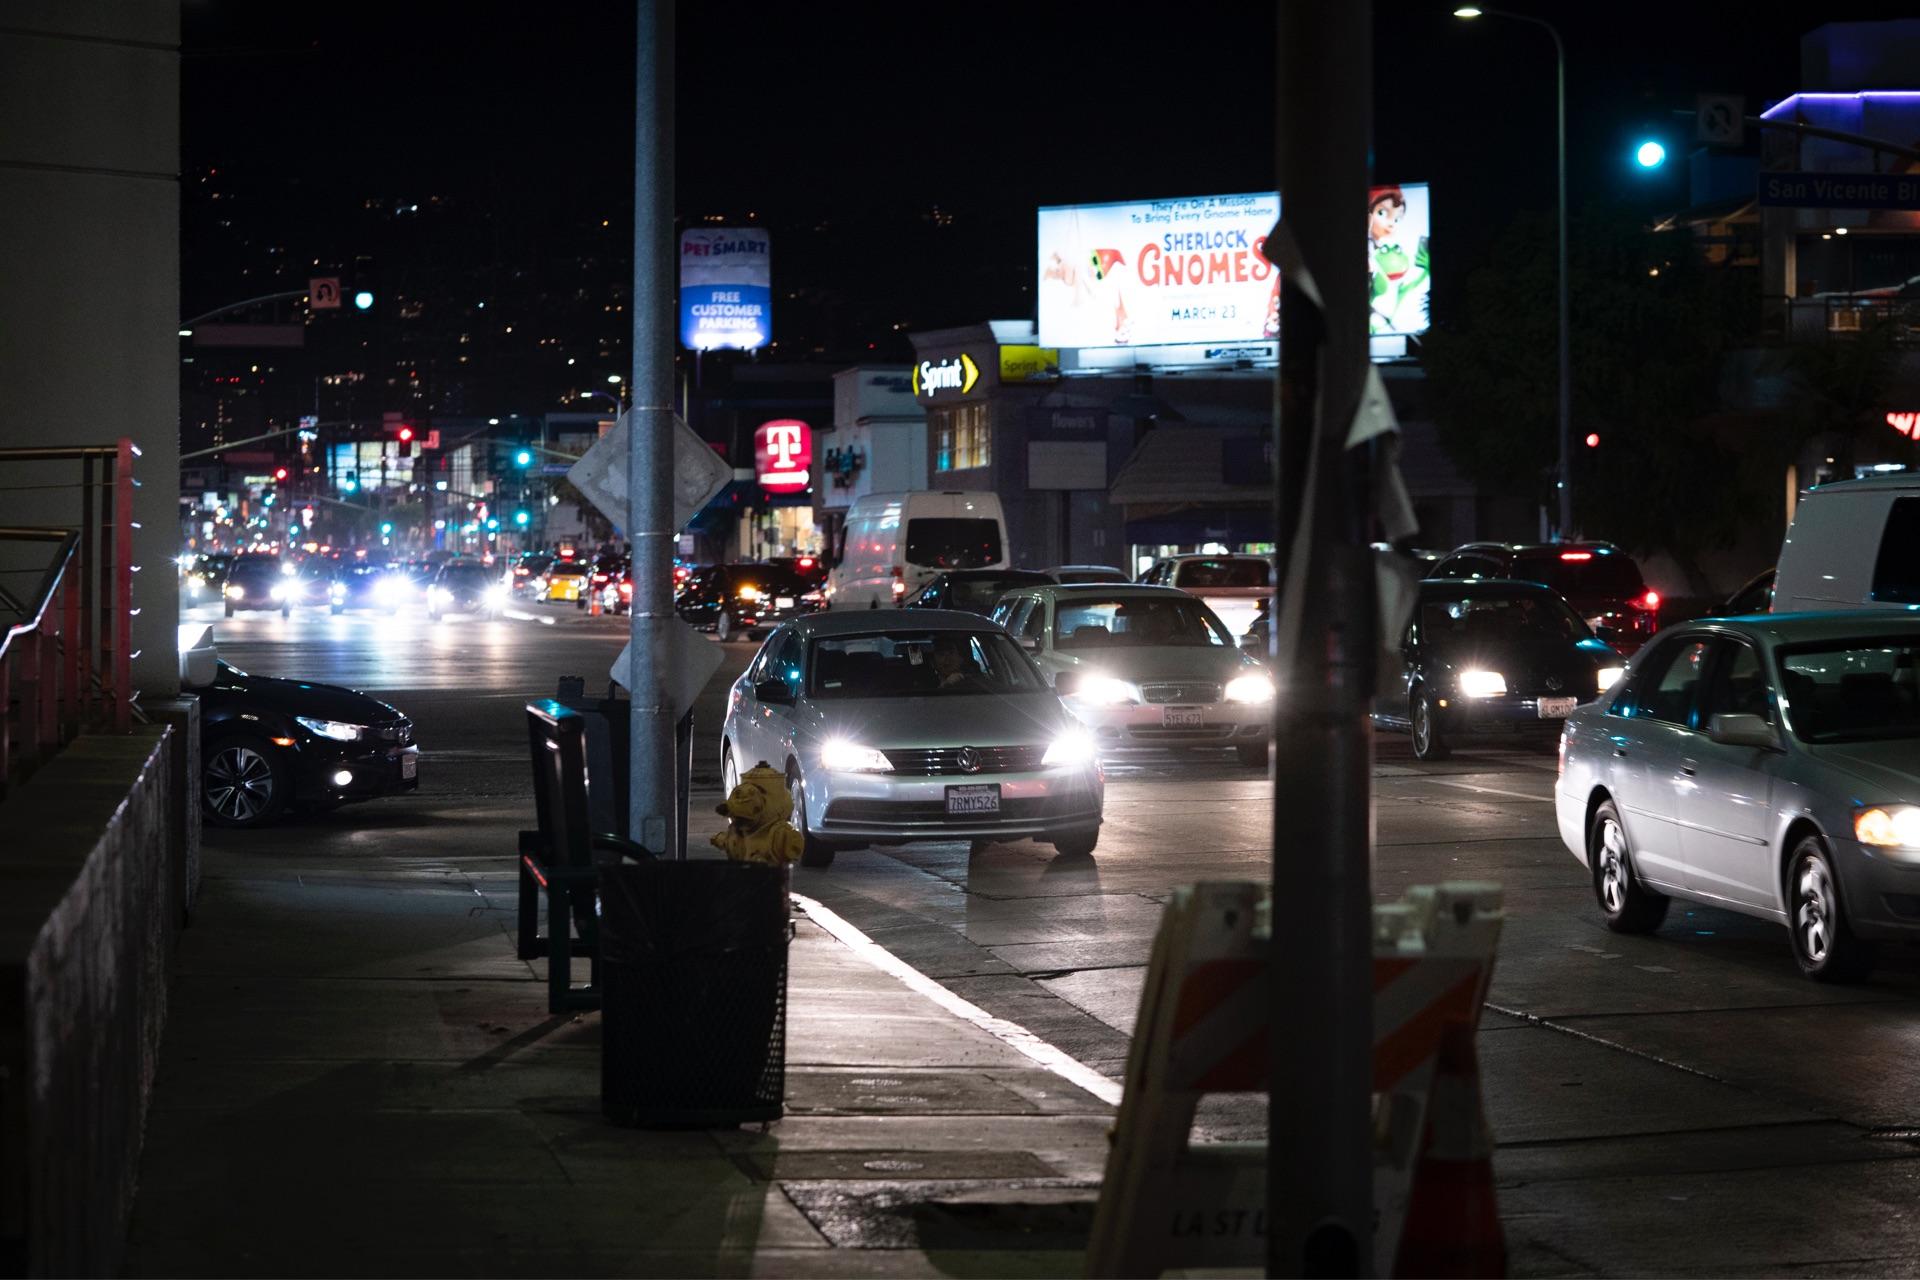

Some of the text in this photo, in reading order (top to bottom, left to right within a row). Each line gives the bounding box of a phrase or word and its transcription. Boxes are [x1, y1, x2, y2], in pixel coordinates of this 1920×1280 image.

[1767, 178, 1807, 200] San
[1813, 180, 1889, 201] Vicente
[1190, 199, 1205, 209] On
[1208, 198, 1216, 207] A
[1219, 196, 1256, 206] Mission
[1131, 207, 1272, 224] To Bring Every Gnome Home
[1164, 229, 1249, 252] SHERLOCK
[1138, 235, 1272, 287] GNOMES
[711, 291, 742, 304] FREE
[691, 304, 763, 317] CUSTOMER
[1172, 304, 1236, 320] MARCH 23
[699, 317, 759, 331] PARKING
[1003, 359, 1040, 373] Sprint
[920, 358, 963, 397] Sprint
[767, 426, 802, 469] T
[950, 795, 997, 812] 7RMY526
[1171, 1209, 1204, 1238] LA
